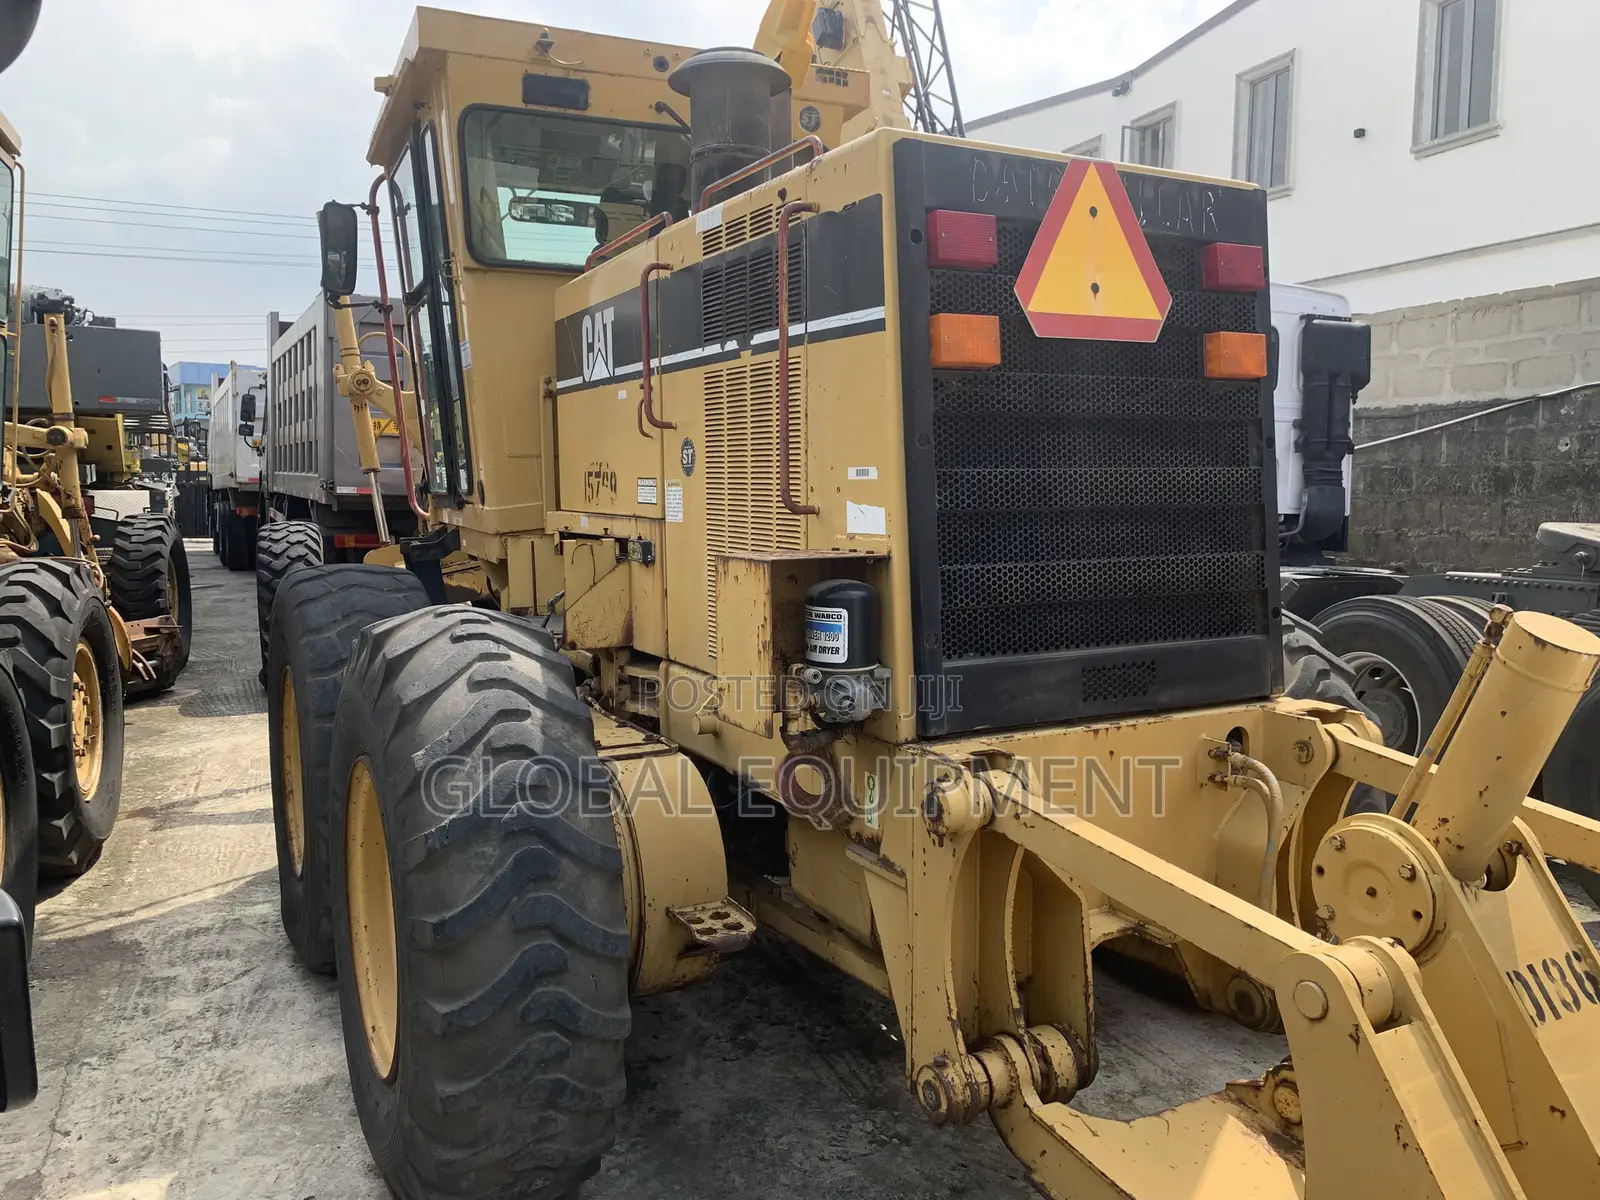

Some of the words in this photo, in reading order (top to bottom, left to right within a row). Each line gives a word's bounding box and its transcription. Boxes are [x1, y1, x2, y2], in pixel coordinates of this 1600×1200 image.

[582, 306, 615, 383] CAT
[682, 449, 694, 465] ST
[822, 631, 840, 642] 1200
[809, 644, 818, 653] AIR
[819, 646, 840, 655] DRYER
